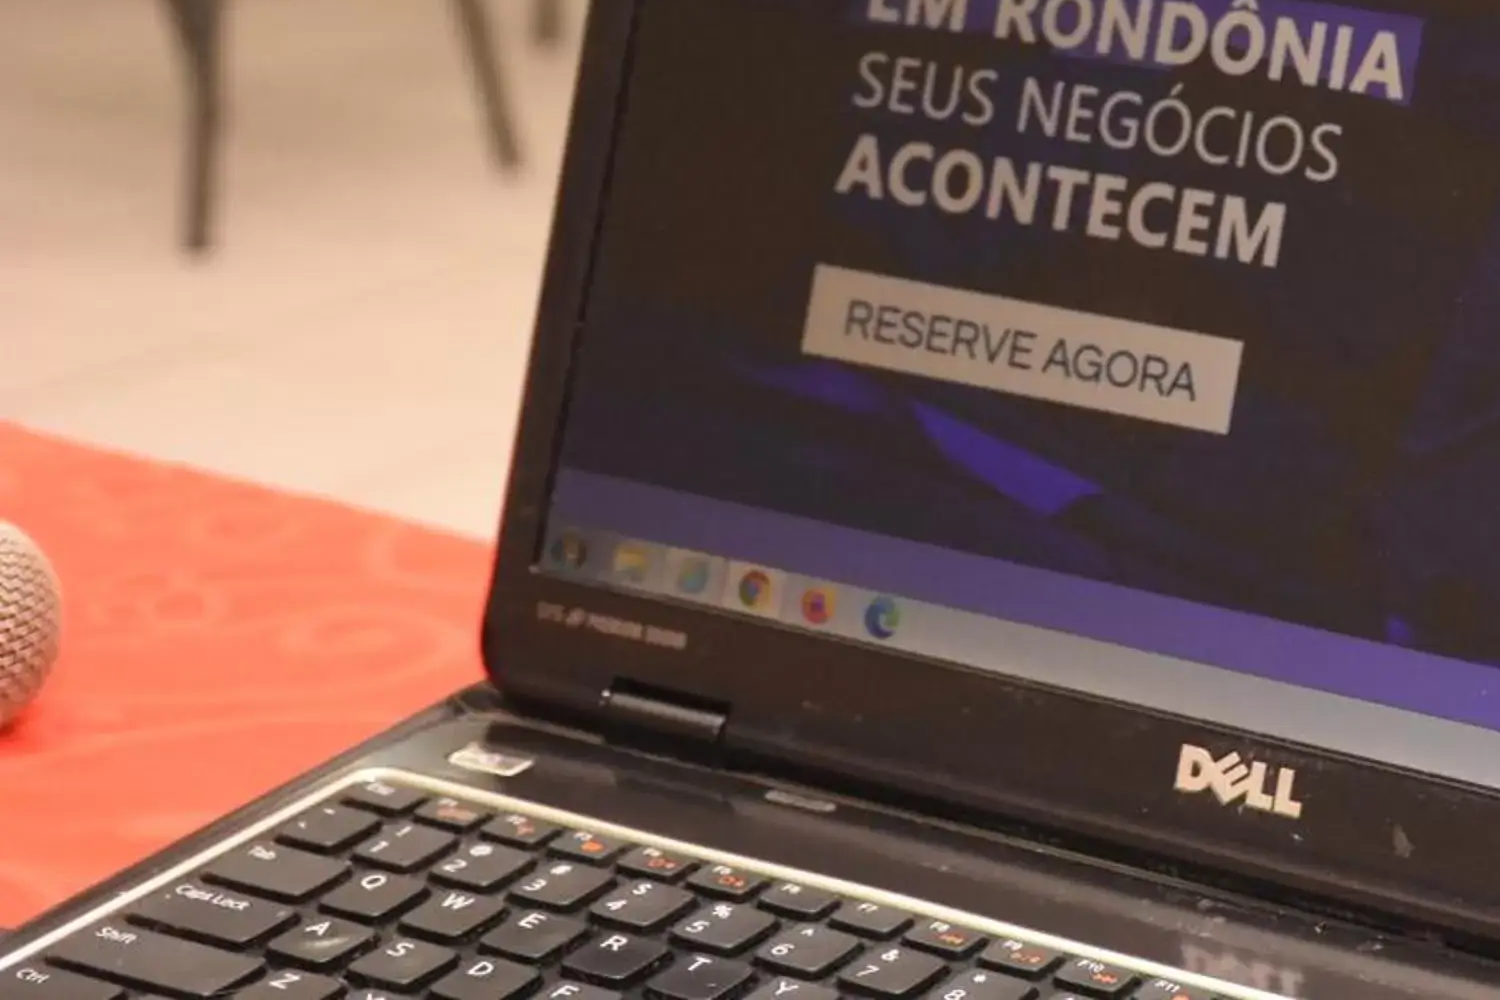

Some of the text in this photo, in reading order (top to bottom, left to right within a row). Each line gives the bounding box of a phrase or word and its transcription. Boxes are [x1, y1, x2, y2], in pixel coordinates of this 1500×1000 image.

[852, 51, 1344, 183] SEUS NEGÓCIOS
[833, 133, 1288, 269] ACONTECEM
[843, 299, 1197, 403] RESERVE AGORA
[1173, 743, 1304, 820] DELL
[249, 845, 278, 862] Tab
[442, 858, 468, 873] 2
[360, 873, 388, 892] Q
[521, 878, 548, 893] 3
[440, 892, 476, 911] W
[605, 899, 628, 912] 4
[304, 920, 332, 937] A
[517, 912, 548, 930] E
[685, 919, 711, 934] 5
[95, 925, 139, 946] Shift
[600, 934, 629, 952] R
[385, 942, 416, 958] S
[770, 943, 796, 957] 6
[465, 960, 495, 977] D
[686, 955, 714, 973] T
[856, 963, 881, 978] 7
[14, 966, 52, 985] Ctrl
[268, 972, 301, 991] Z
[550, 984, 580, 1000] F
[774, 980, 800, 996] Y
[943, 988, 967, 1000] 8
